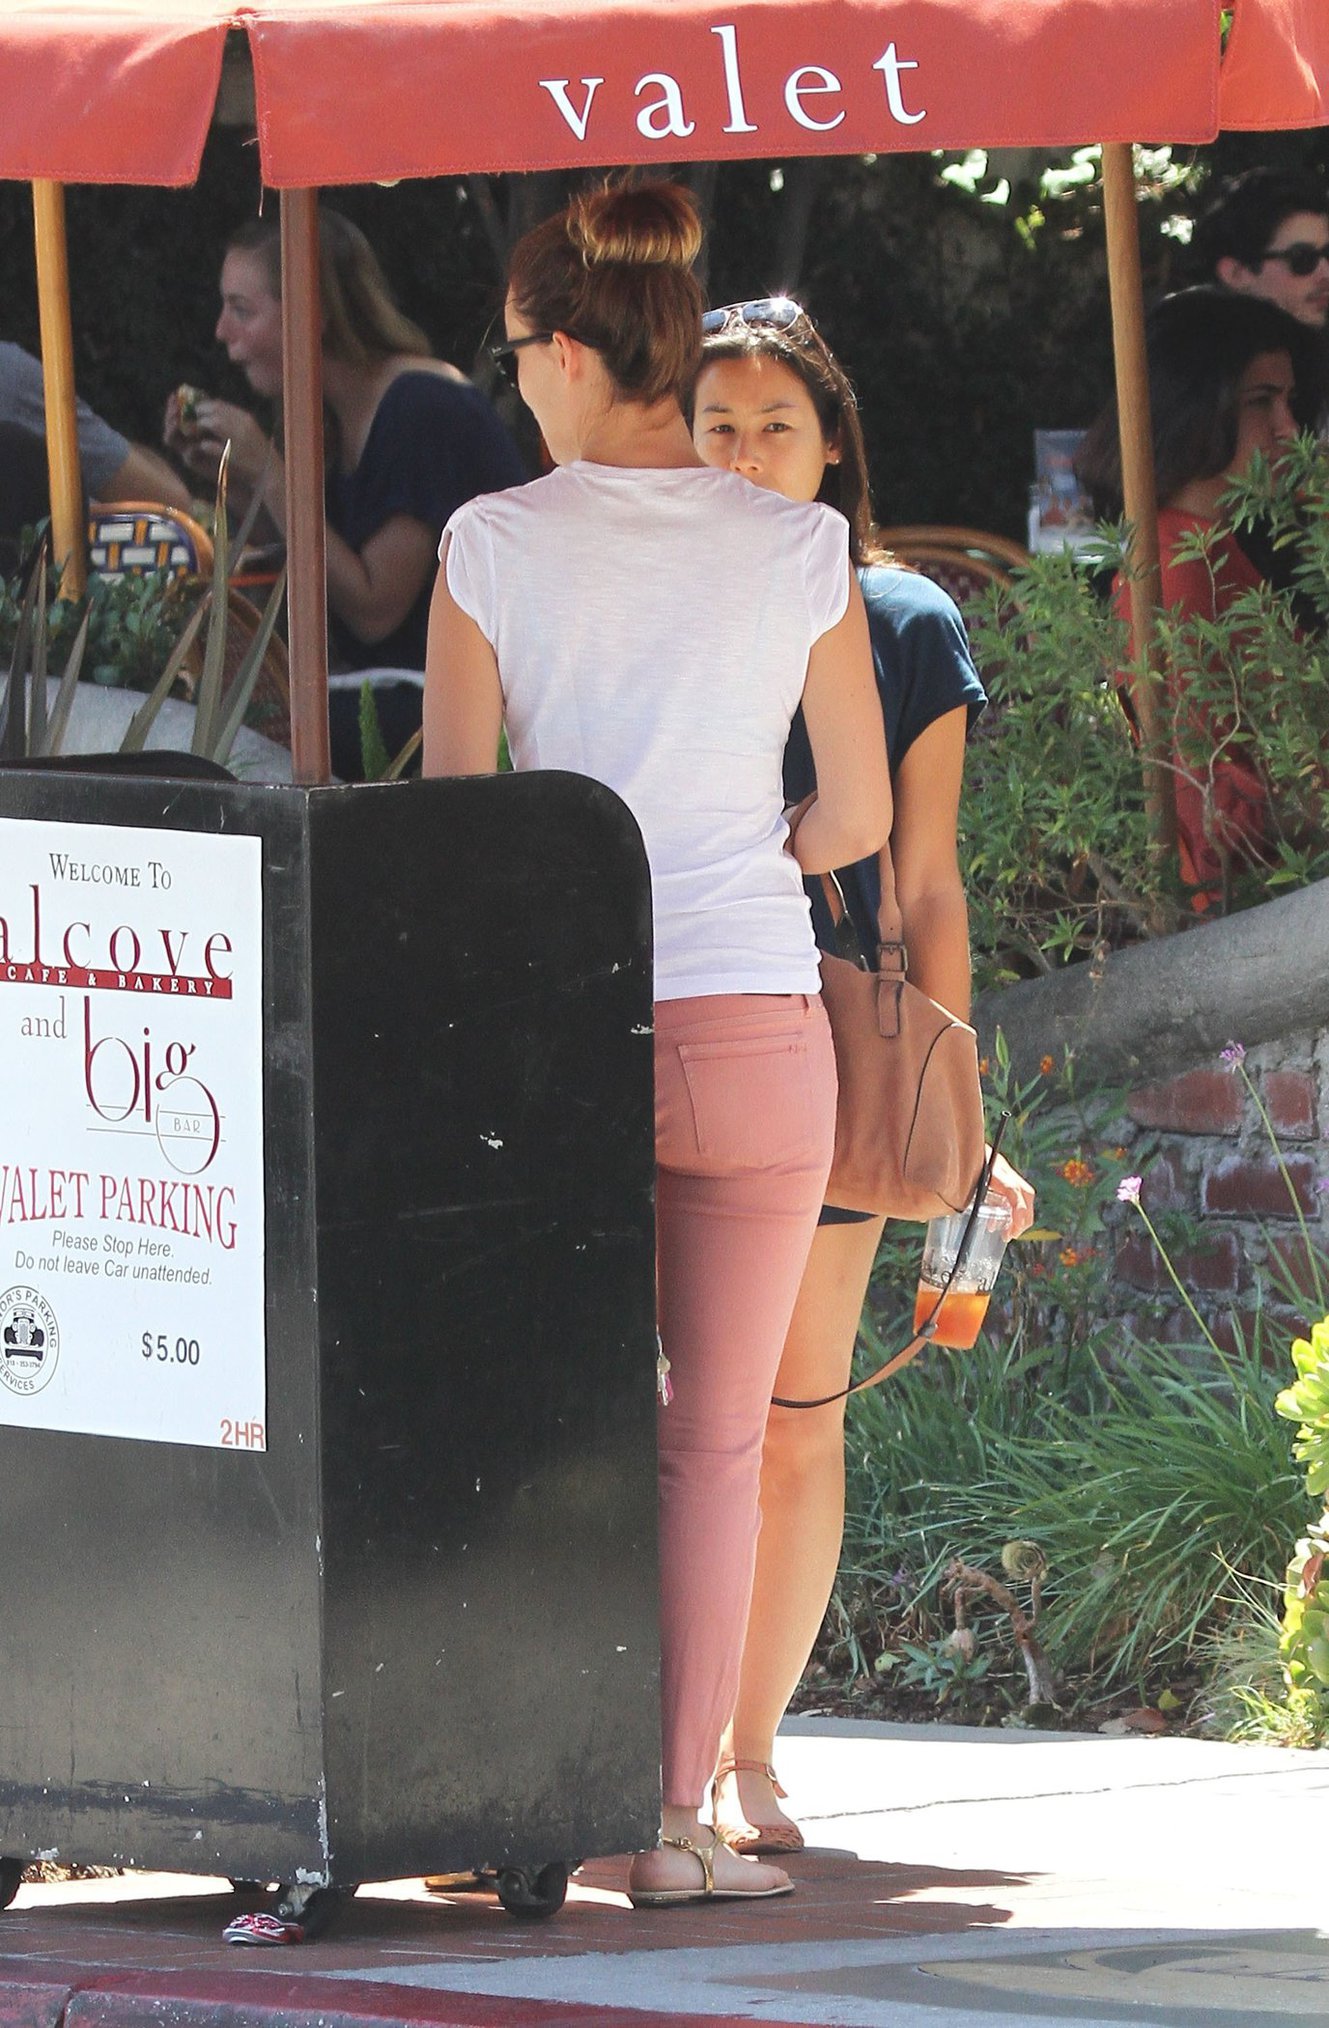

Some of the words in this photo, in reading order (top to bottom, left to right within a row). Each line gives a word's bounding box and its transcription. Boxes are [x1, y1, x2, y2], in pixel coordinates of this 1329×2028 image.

[538, 24, 927, 141] valet
[88, 972, 97, 987] &
[118, 974, 215, 996] BAKERY
[21, 995, 68, 1040] and
[84, 995, 220, 1175] big
[174, 1117, 201, 1134] BAR
[99, 1174, 237, 1249] PARKING
[52, 1230, 98, 1251] Please
[103, 1234, 133, 1258] Stop
[138, 1238, 174, 1258] Here.
[15, 1250, 34, 1269] Do
[38, 1255, 60, 1272] not
[63, 1254, 99, 1276] leave
[104, 1259, 129, 1278] Car
[132, 1264, 212, 1286] unattended.
[25, 1290, 57, 1348] PARKING
[142, 1330, 200, 1366] $5.00
[220, 1418, 265, 1450] 2HR
